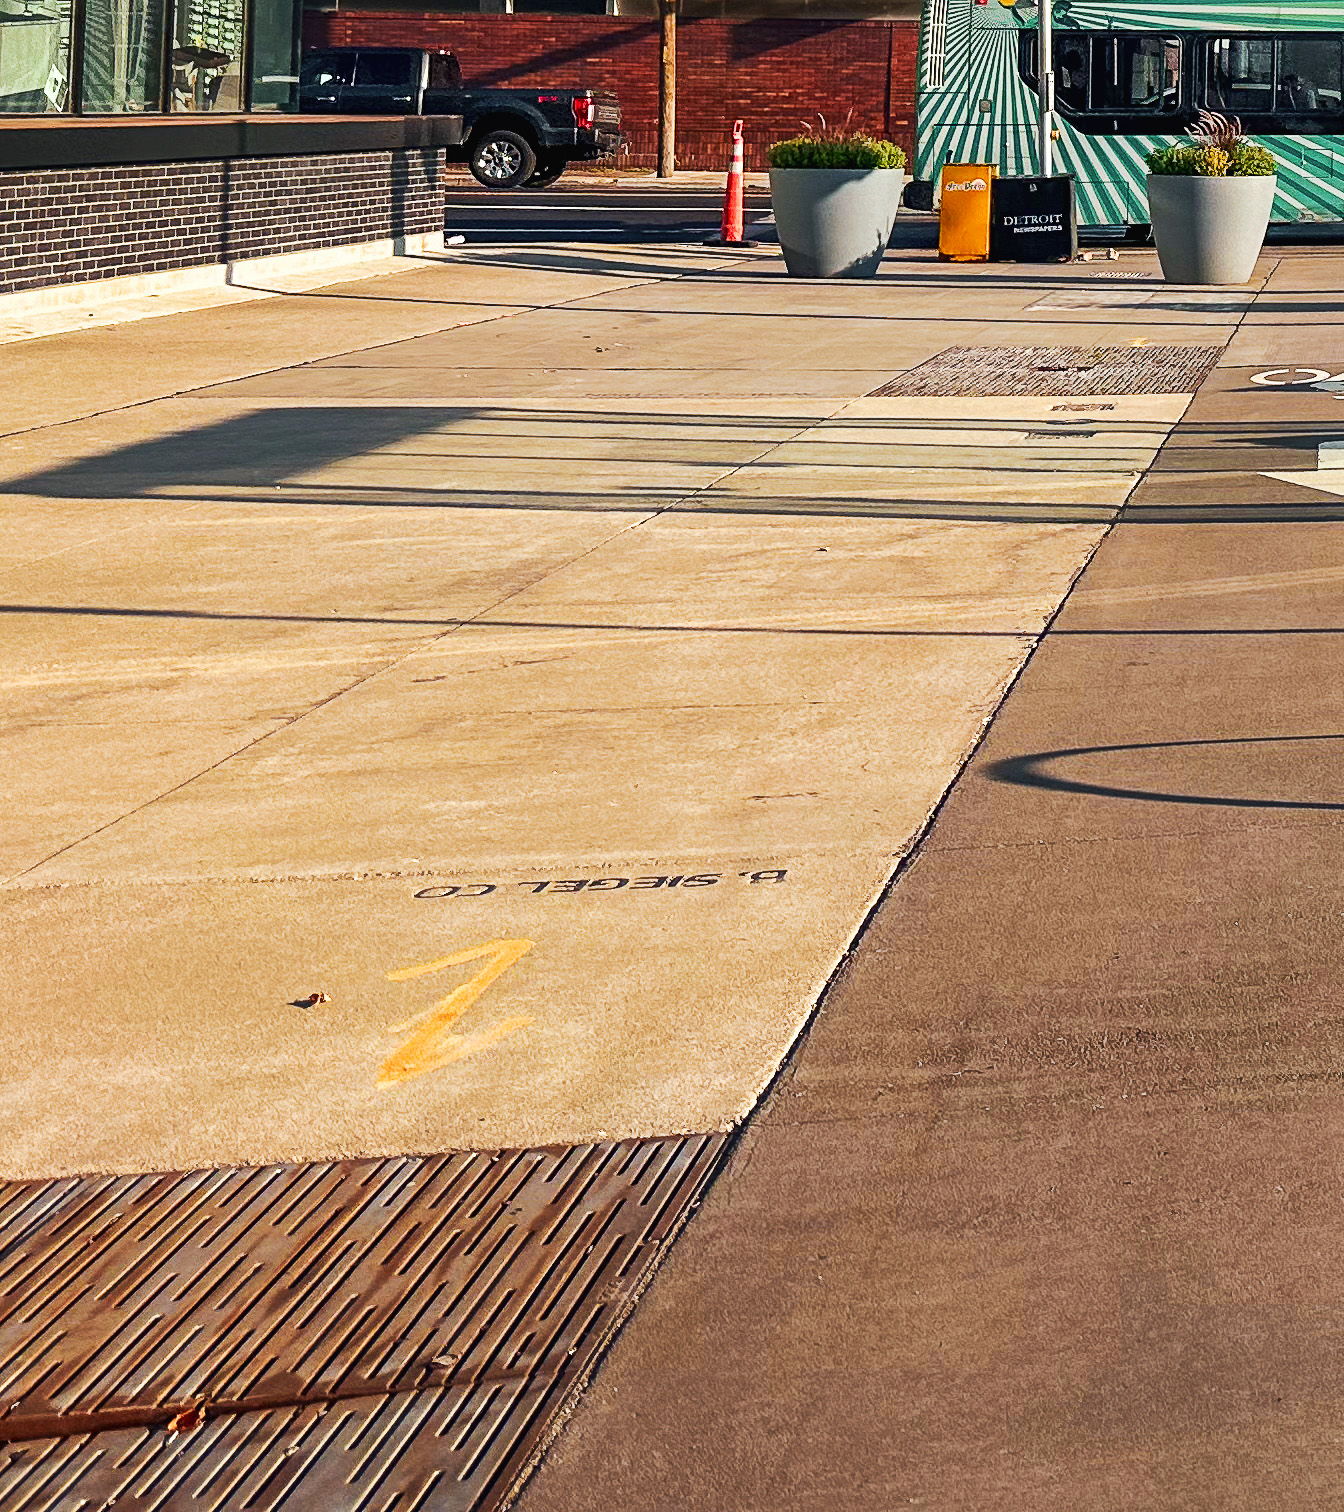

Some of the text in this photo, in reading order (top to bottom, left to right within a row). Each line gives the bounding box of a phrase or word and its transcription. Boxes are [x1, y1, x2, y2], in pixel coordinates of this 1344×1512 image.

[1003, 213, 1063, 226] DETROIT
[1013, 225, 1063, 234] NEWSPAPERS
[517, 872, 723, 895] SIEGEL
